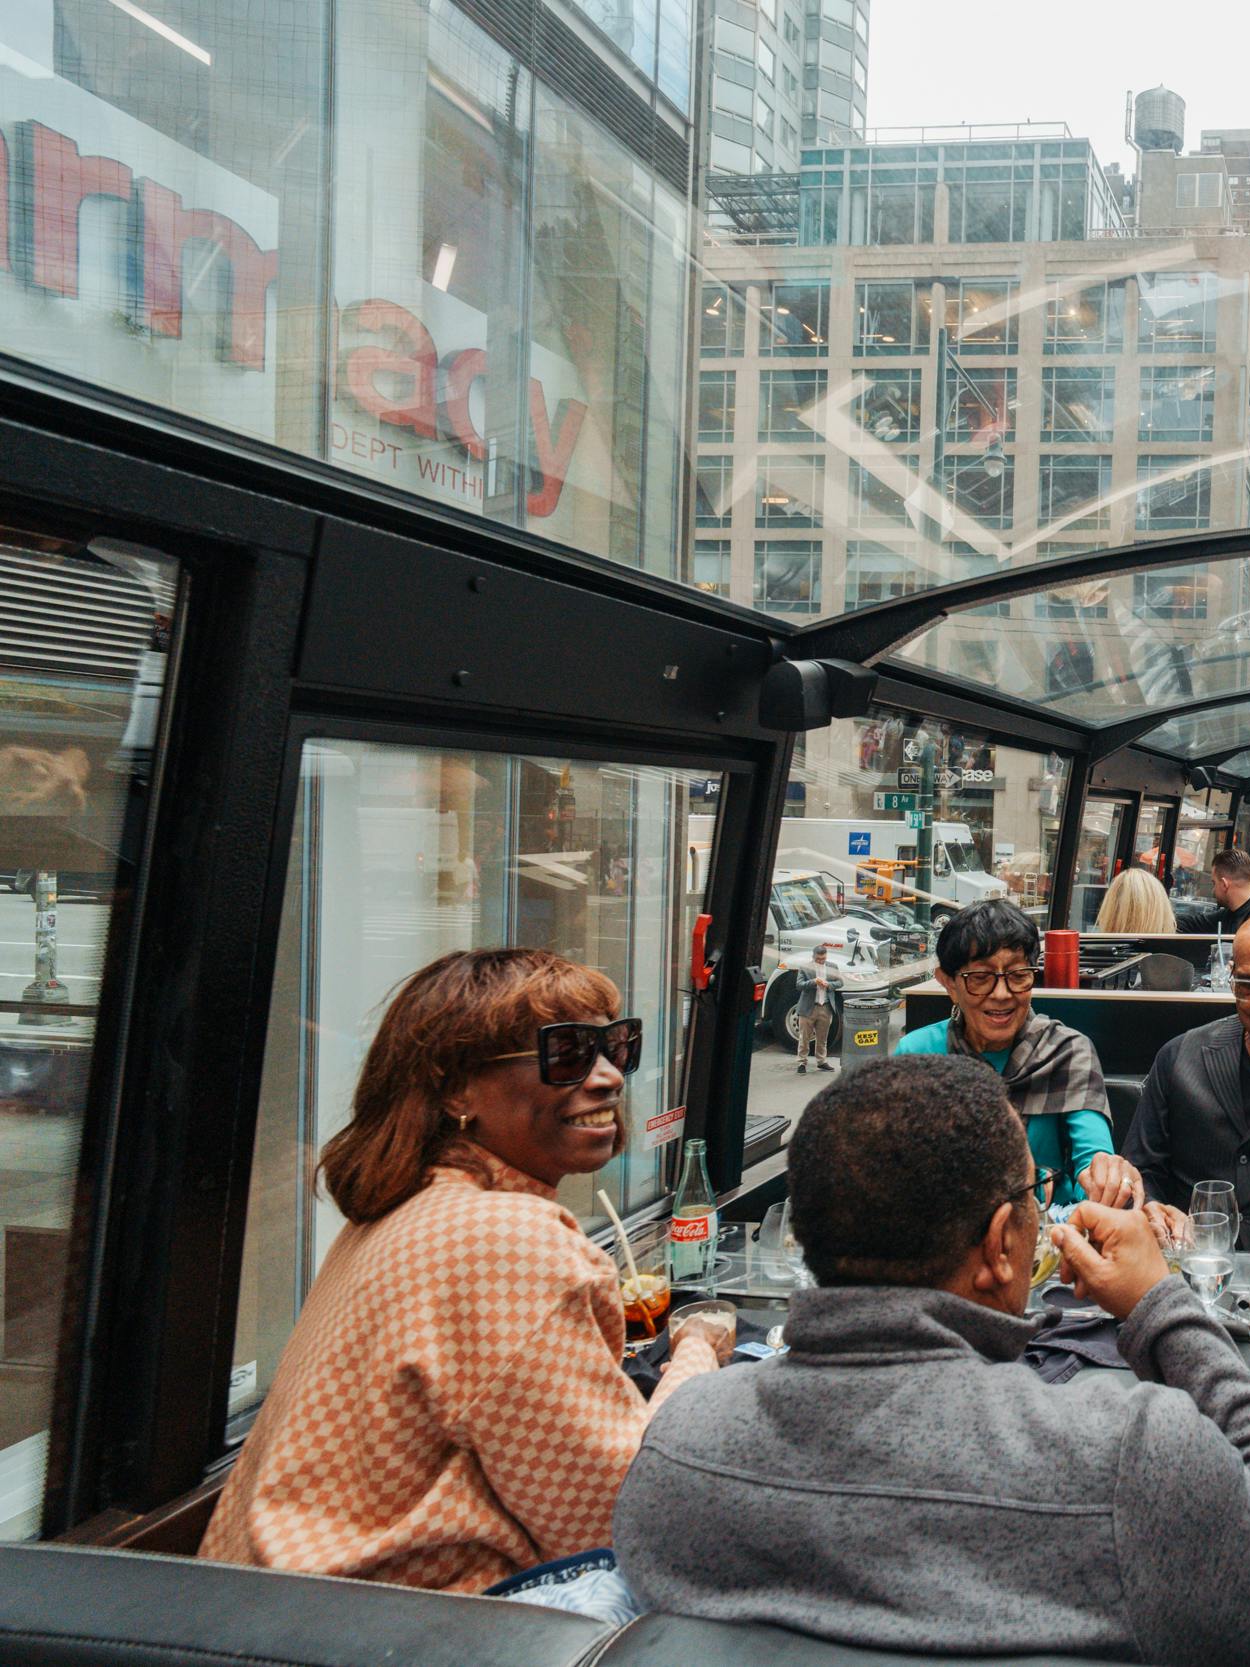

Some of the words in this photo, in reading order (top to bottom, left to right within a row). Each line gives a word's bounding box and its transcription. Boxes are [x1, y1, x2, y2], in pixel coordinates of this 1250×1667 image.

[0, 118, 588, 518] rmacy
[330, 422, 402, 469] DEPT
[903, 774, 921, 784] ONE
[934, 774, 954, 784] WAY
[892, 795, 898, 808] 8
[901, 795, 909, 803] Av
